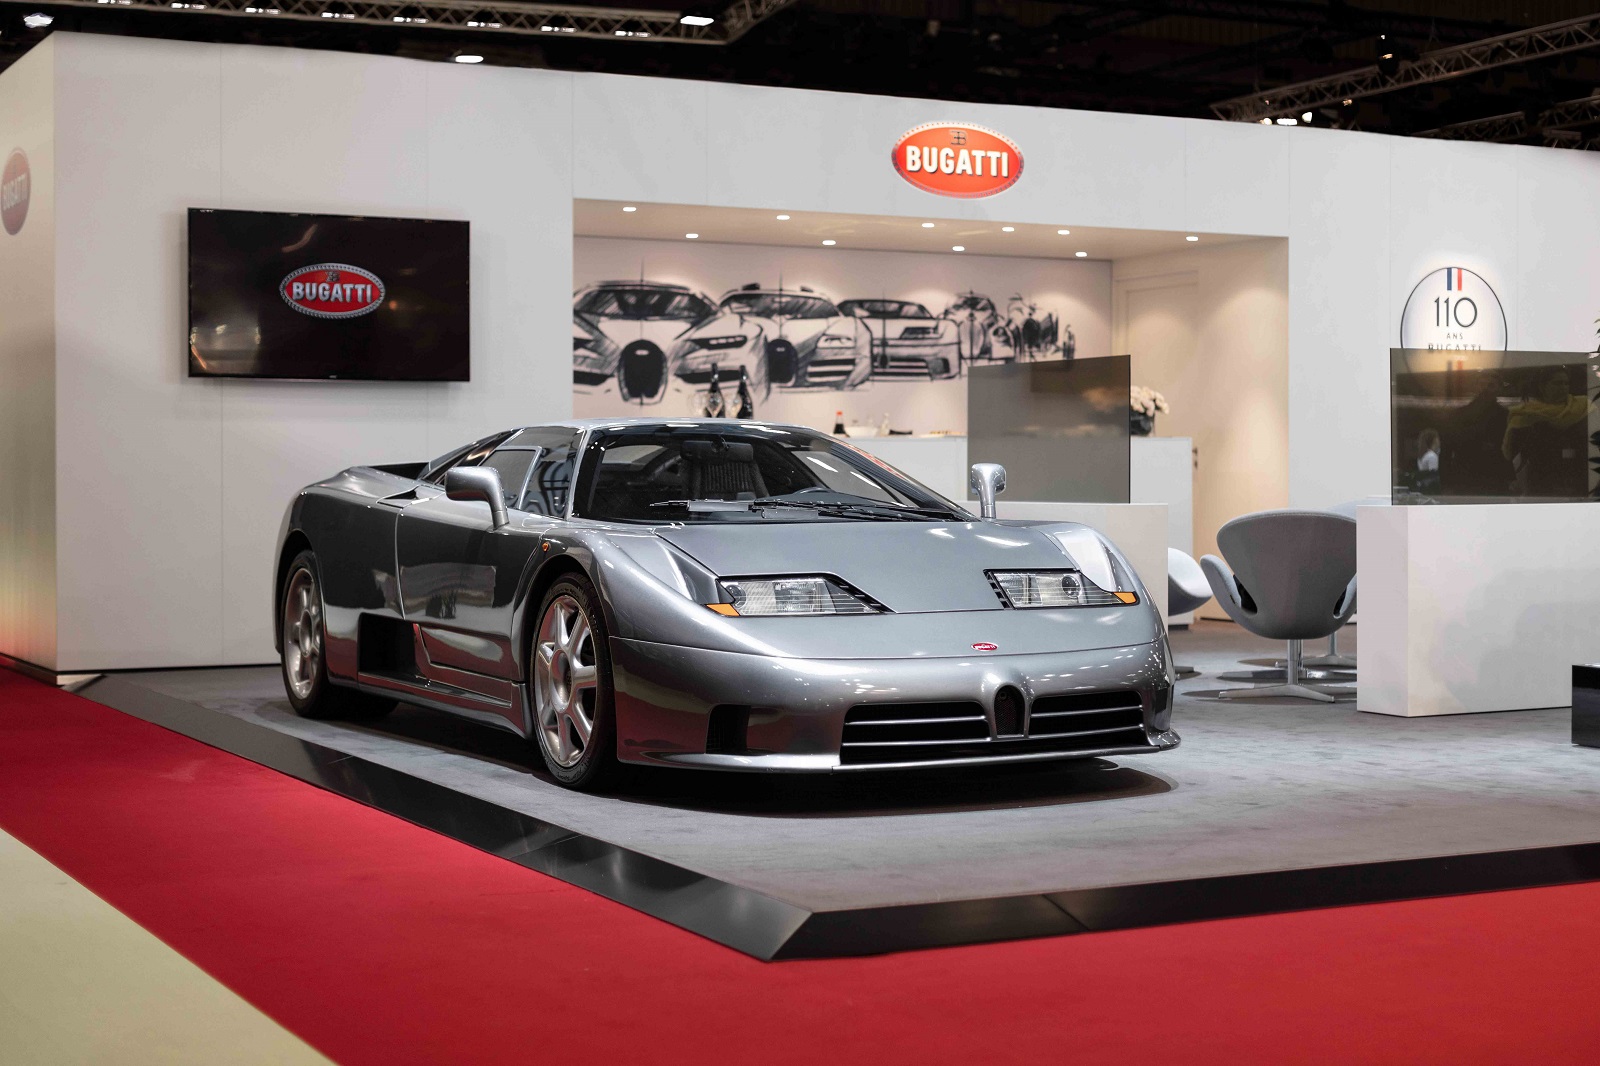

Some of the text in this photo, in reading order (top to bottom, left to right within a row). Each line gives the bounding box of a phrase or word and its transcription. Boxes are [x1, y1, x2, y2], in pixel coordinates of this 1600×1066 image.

[906, 145, 1009, 178] BUGATTI
[292, 282, 372, 303] BUGATTI
[1434, 296, 1478, 328] 110
[1446, 332, 1464, 340] ANS
